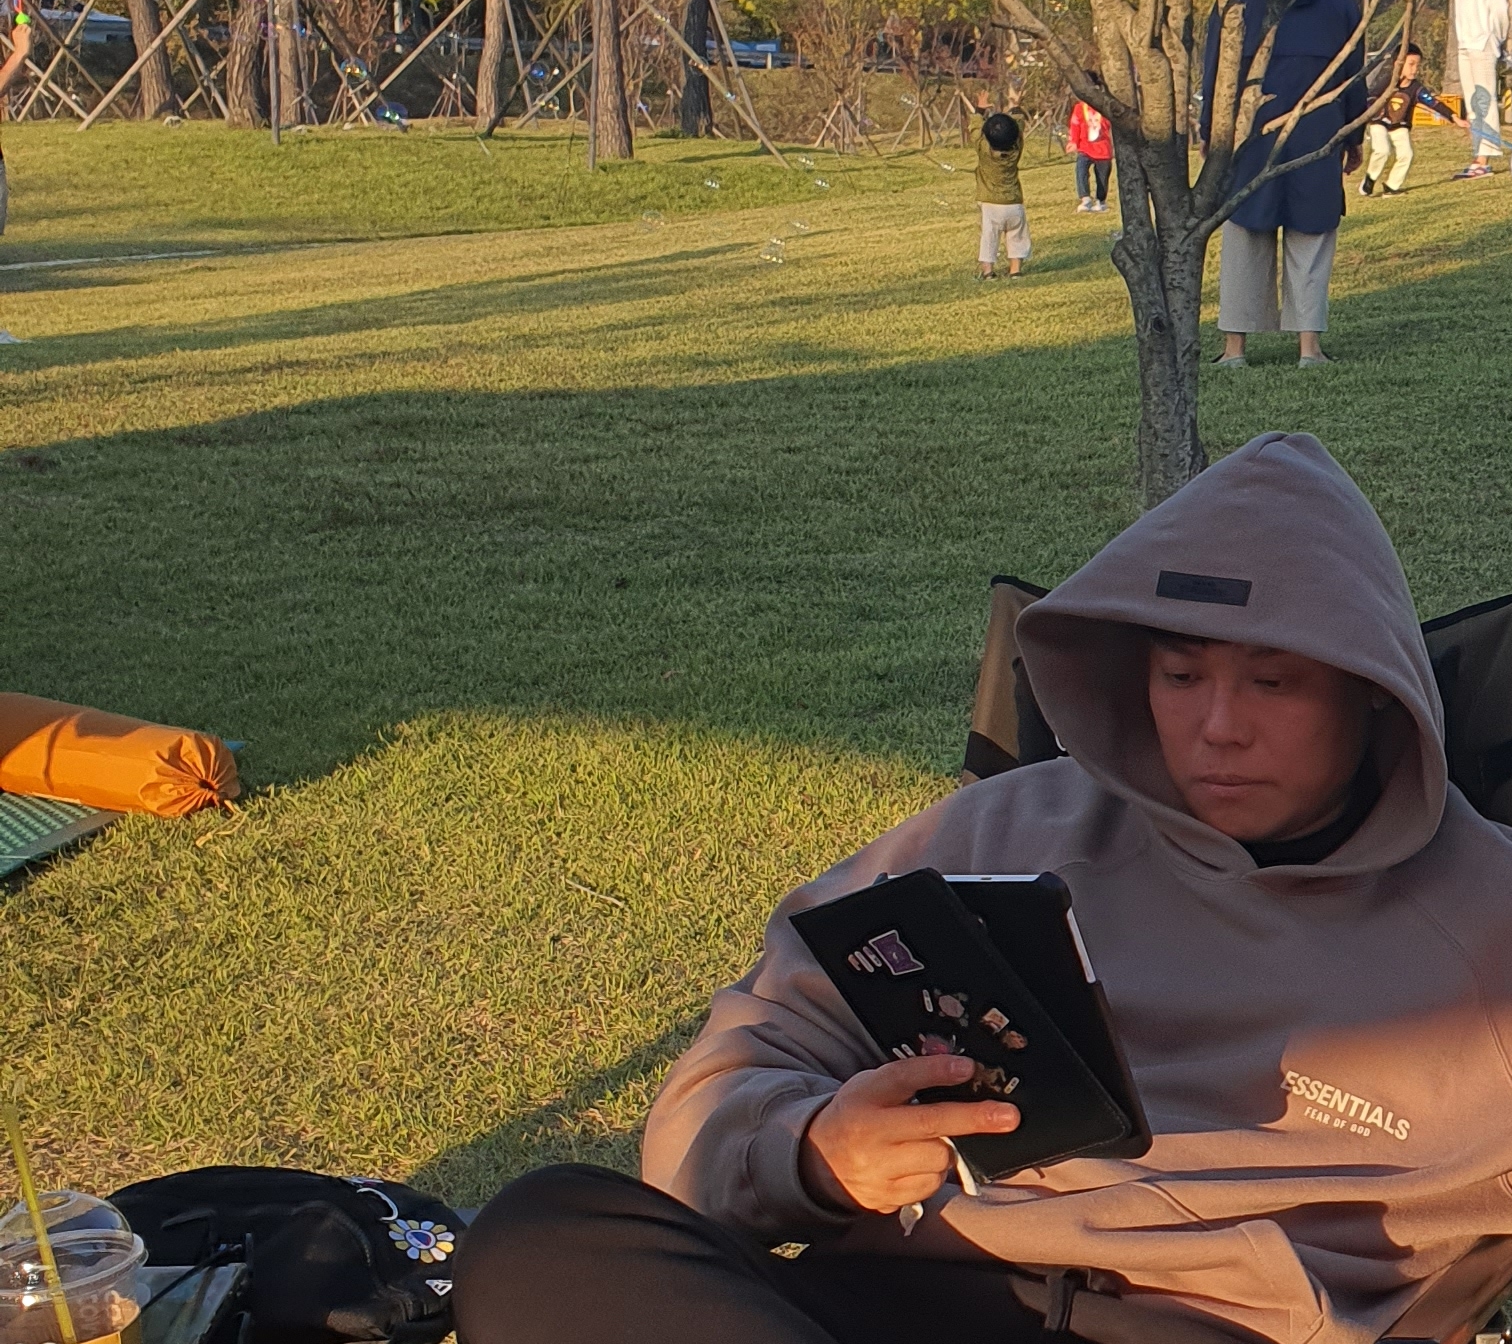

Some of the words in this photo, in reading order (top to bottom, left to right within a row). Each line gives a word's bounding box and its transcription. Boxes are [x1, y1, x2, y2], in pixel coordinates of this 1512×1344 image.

[1280, 1070, 1411, 1141] ESSENTIALS
[1304, 1106, 1330, 1125] FEAR
[1333, 1117, 1348, 1129] OF
